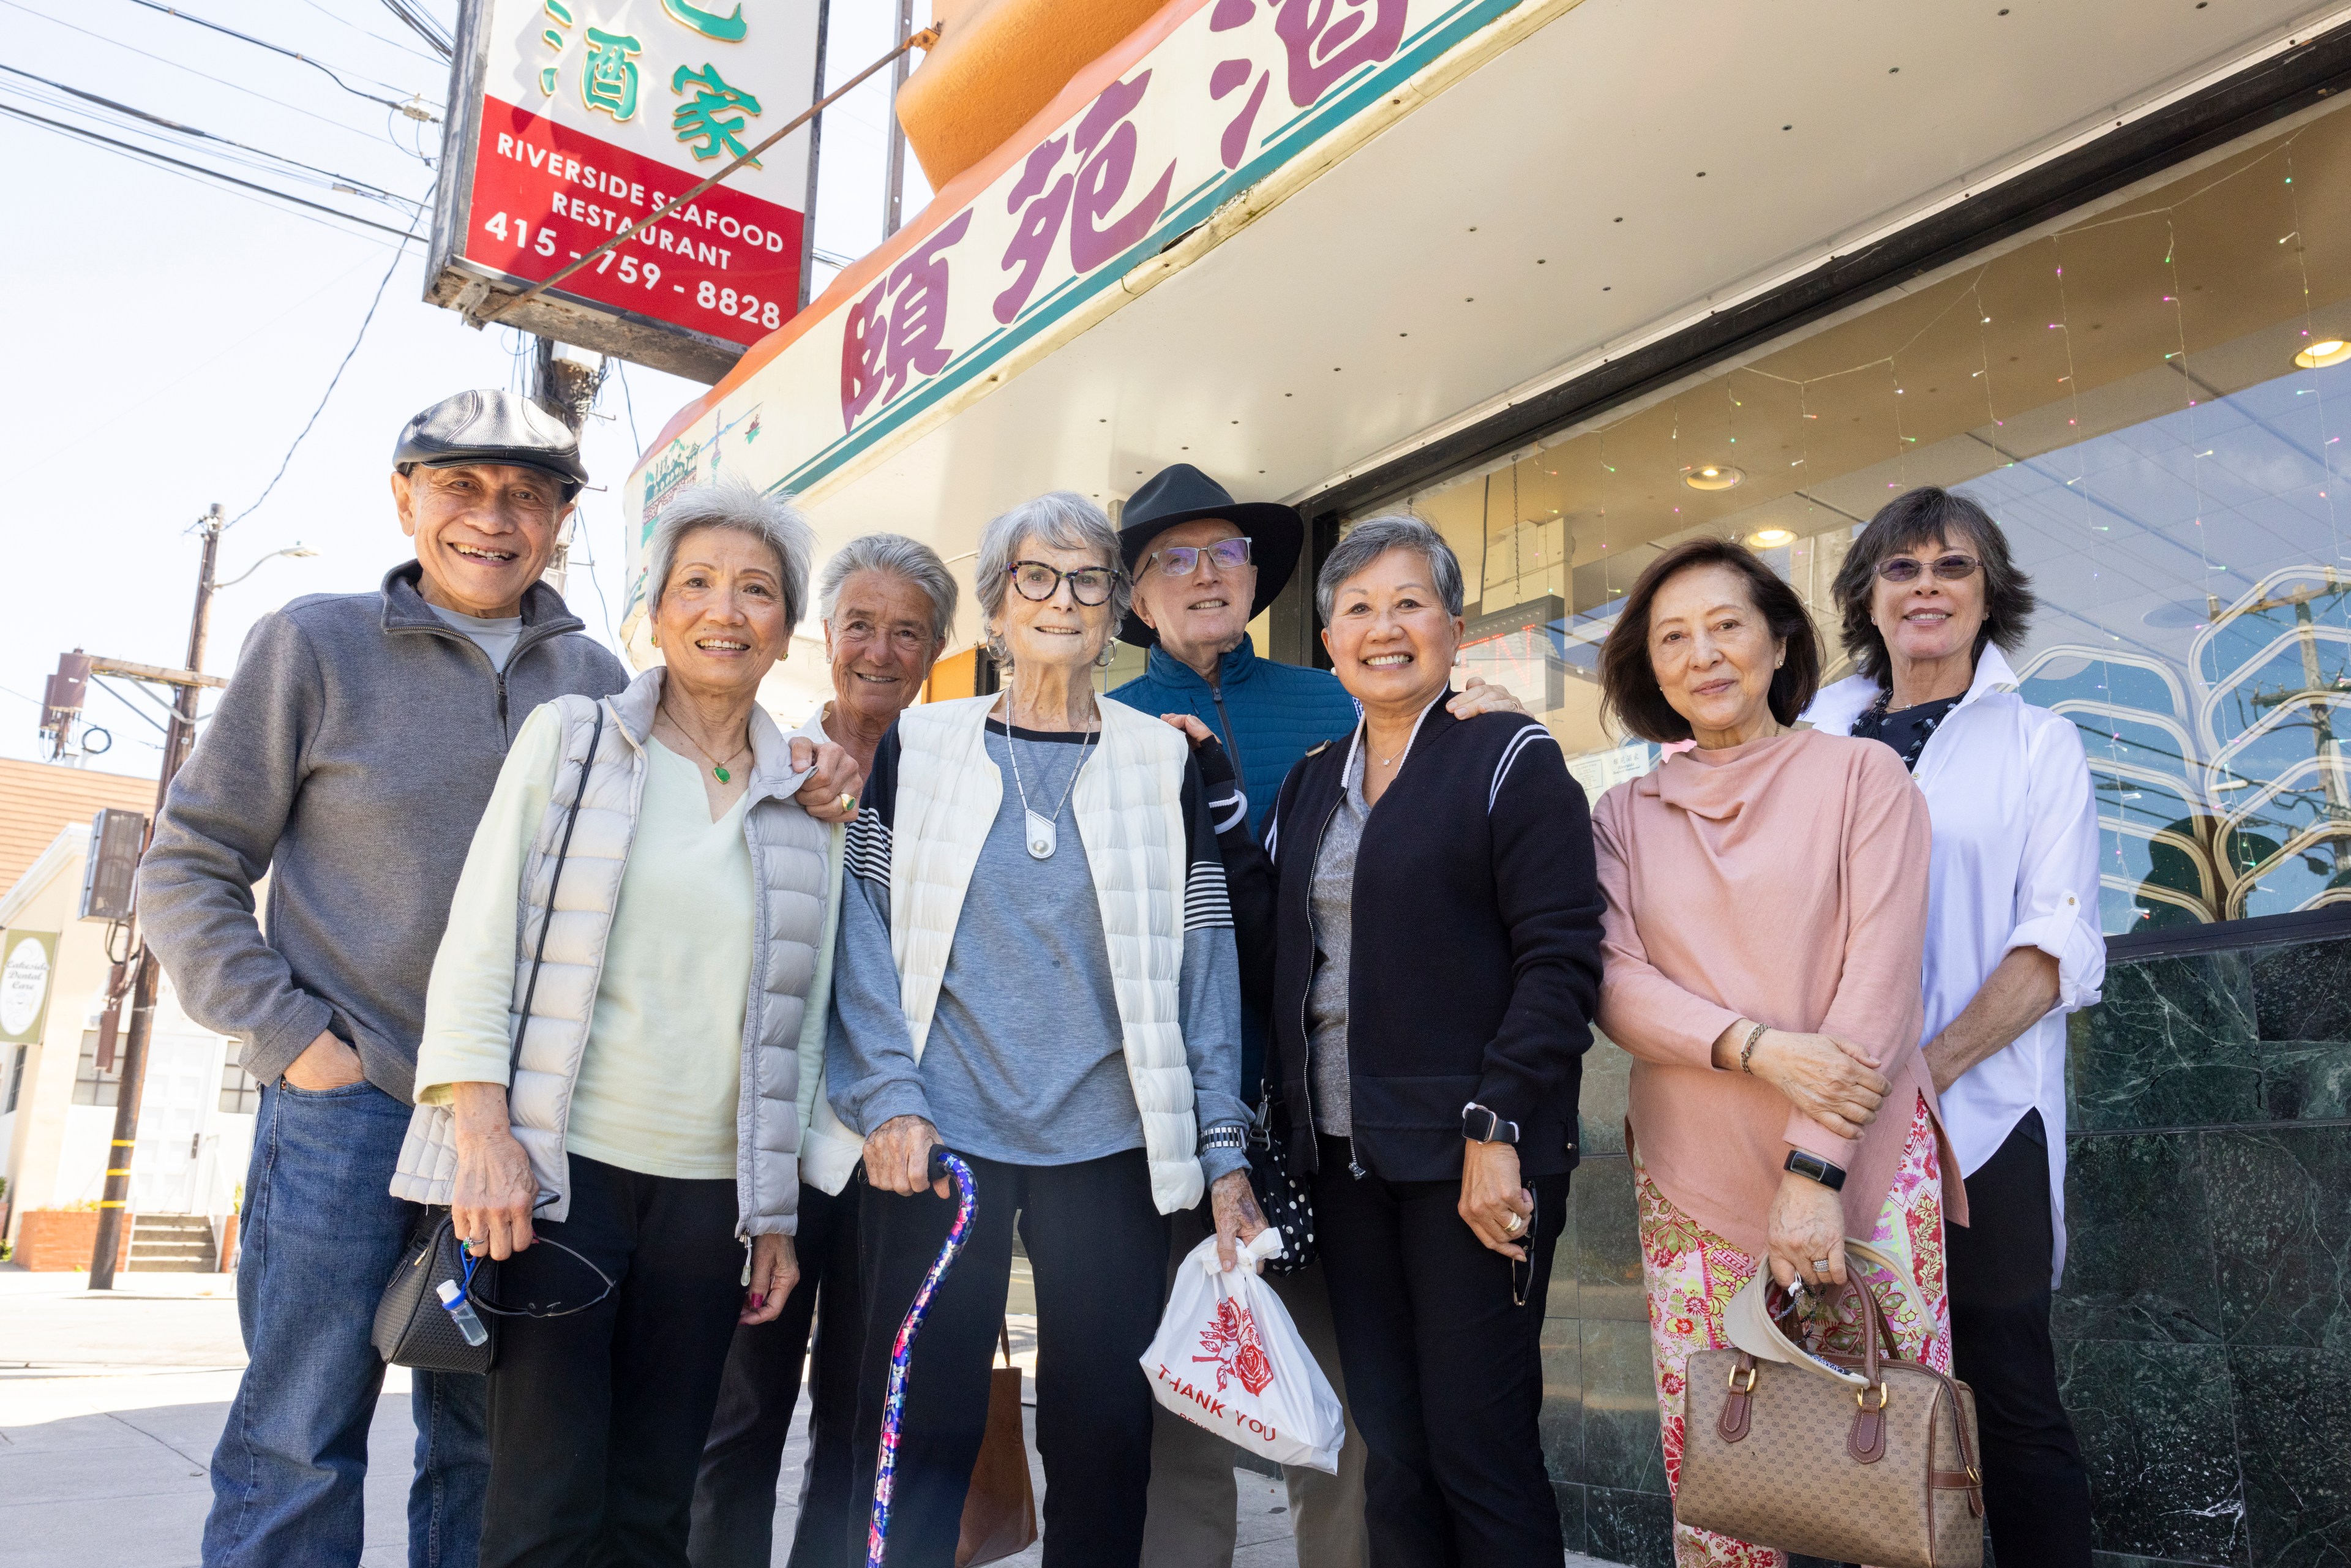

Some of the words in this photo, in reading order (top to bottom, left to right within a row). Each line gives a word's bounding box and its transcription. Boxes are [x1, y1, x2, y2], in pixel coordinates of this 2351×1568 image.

[497, 132, 643, 206] RIVERSIDE
[651, 190, 784, 253] SEAFOOD
[552, 190, 732, 271] RESTAURANT
[485, 211, 557, 257] 415
[596, 246, 661, 291] 759
[696, 281, 781, 330] 8828
[8, 970, 42, 980] Dental
[12, 981, 34, 990] Care
[1158, 1364, 1227, 1419] THANK
[1235, 1409, 1276, 1441] YOU
